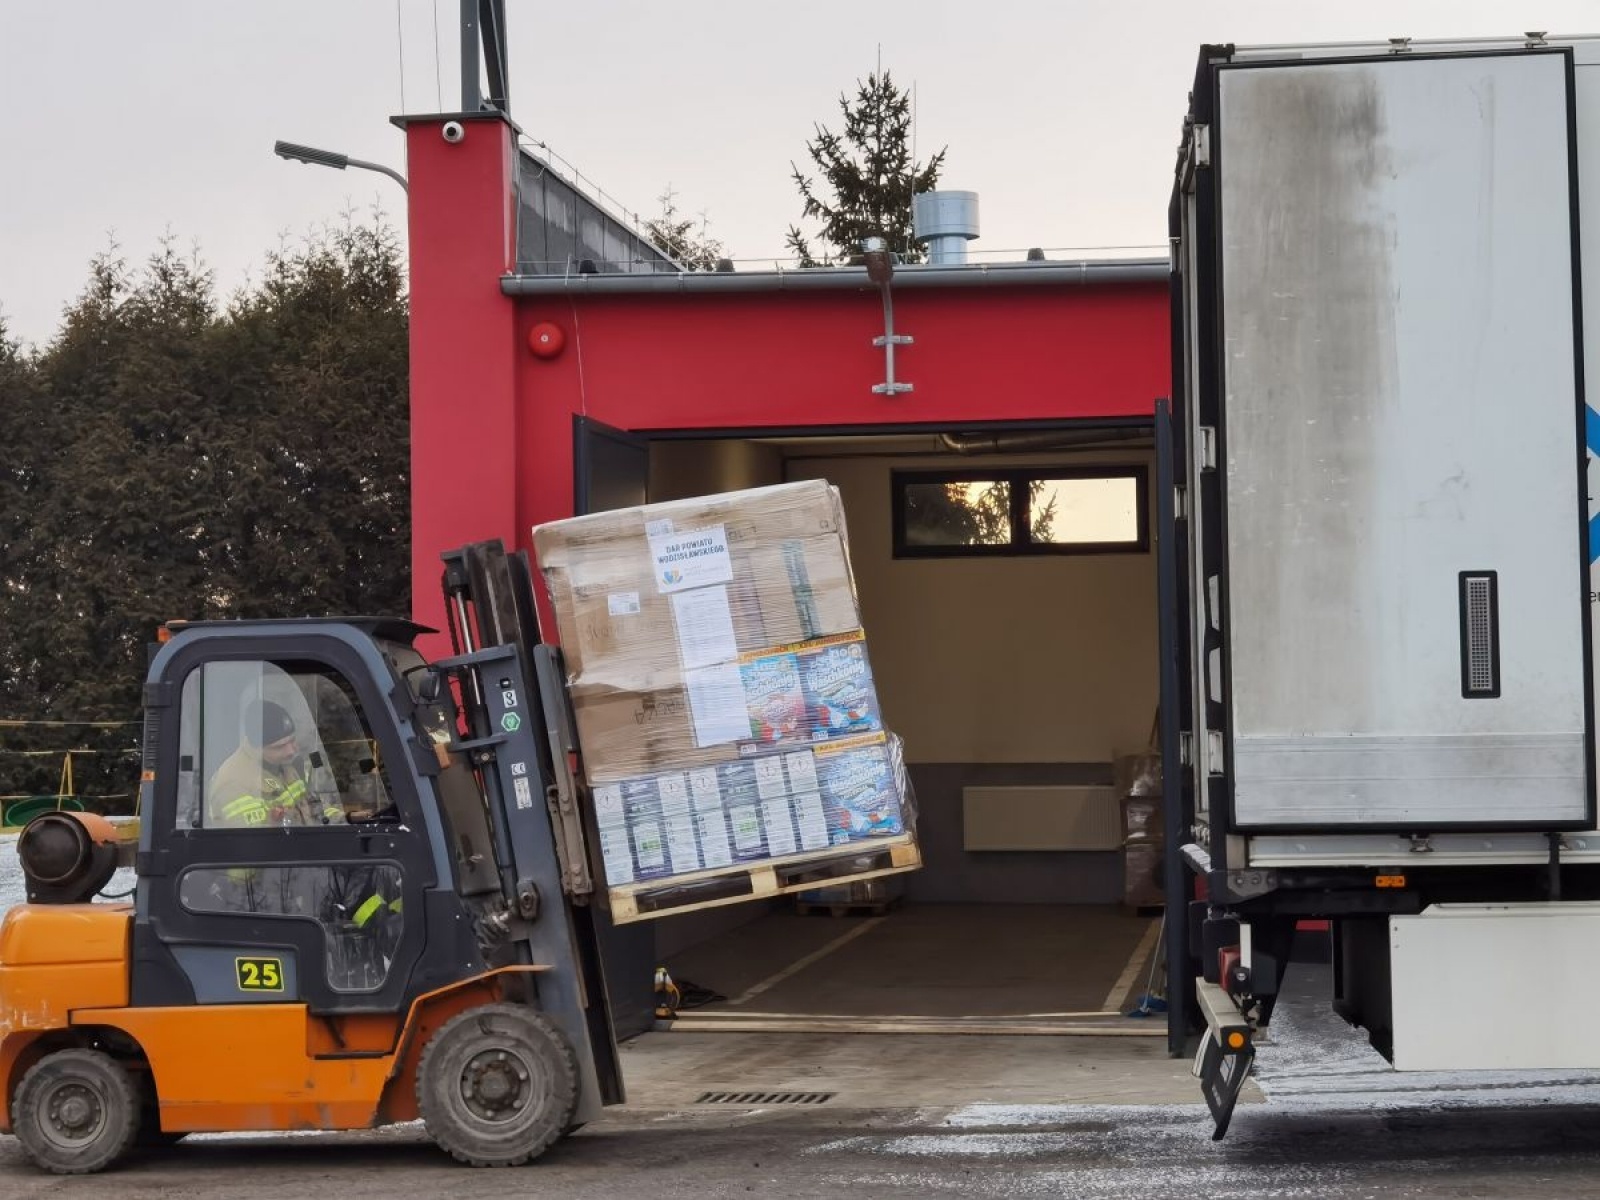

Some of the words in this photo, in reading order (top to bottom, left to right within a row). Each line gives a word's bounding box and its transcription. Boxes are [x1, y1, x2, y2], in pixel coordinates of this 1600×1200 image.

[666, 543, 681, 554] DAR
[682, 538, 713, 550] POWIATU
[241, 962, 279, 986] 25
